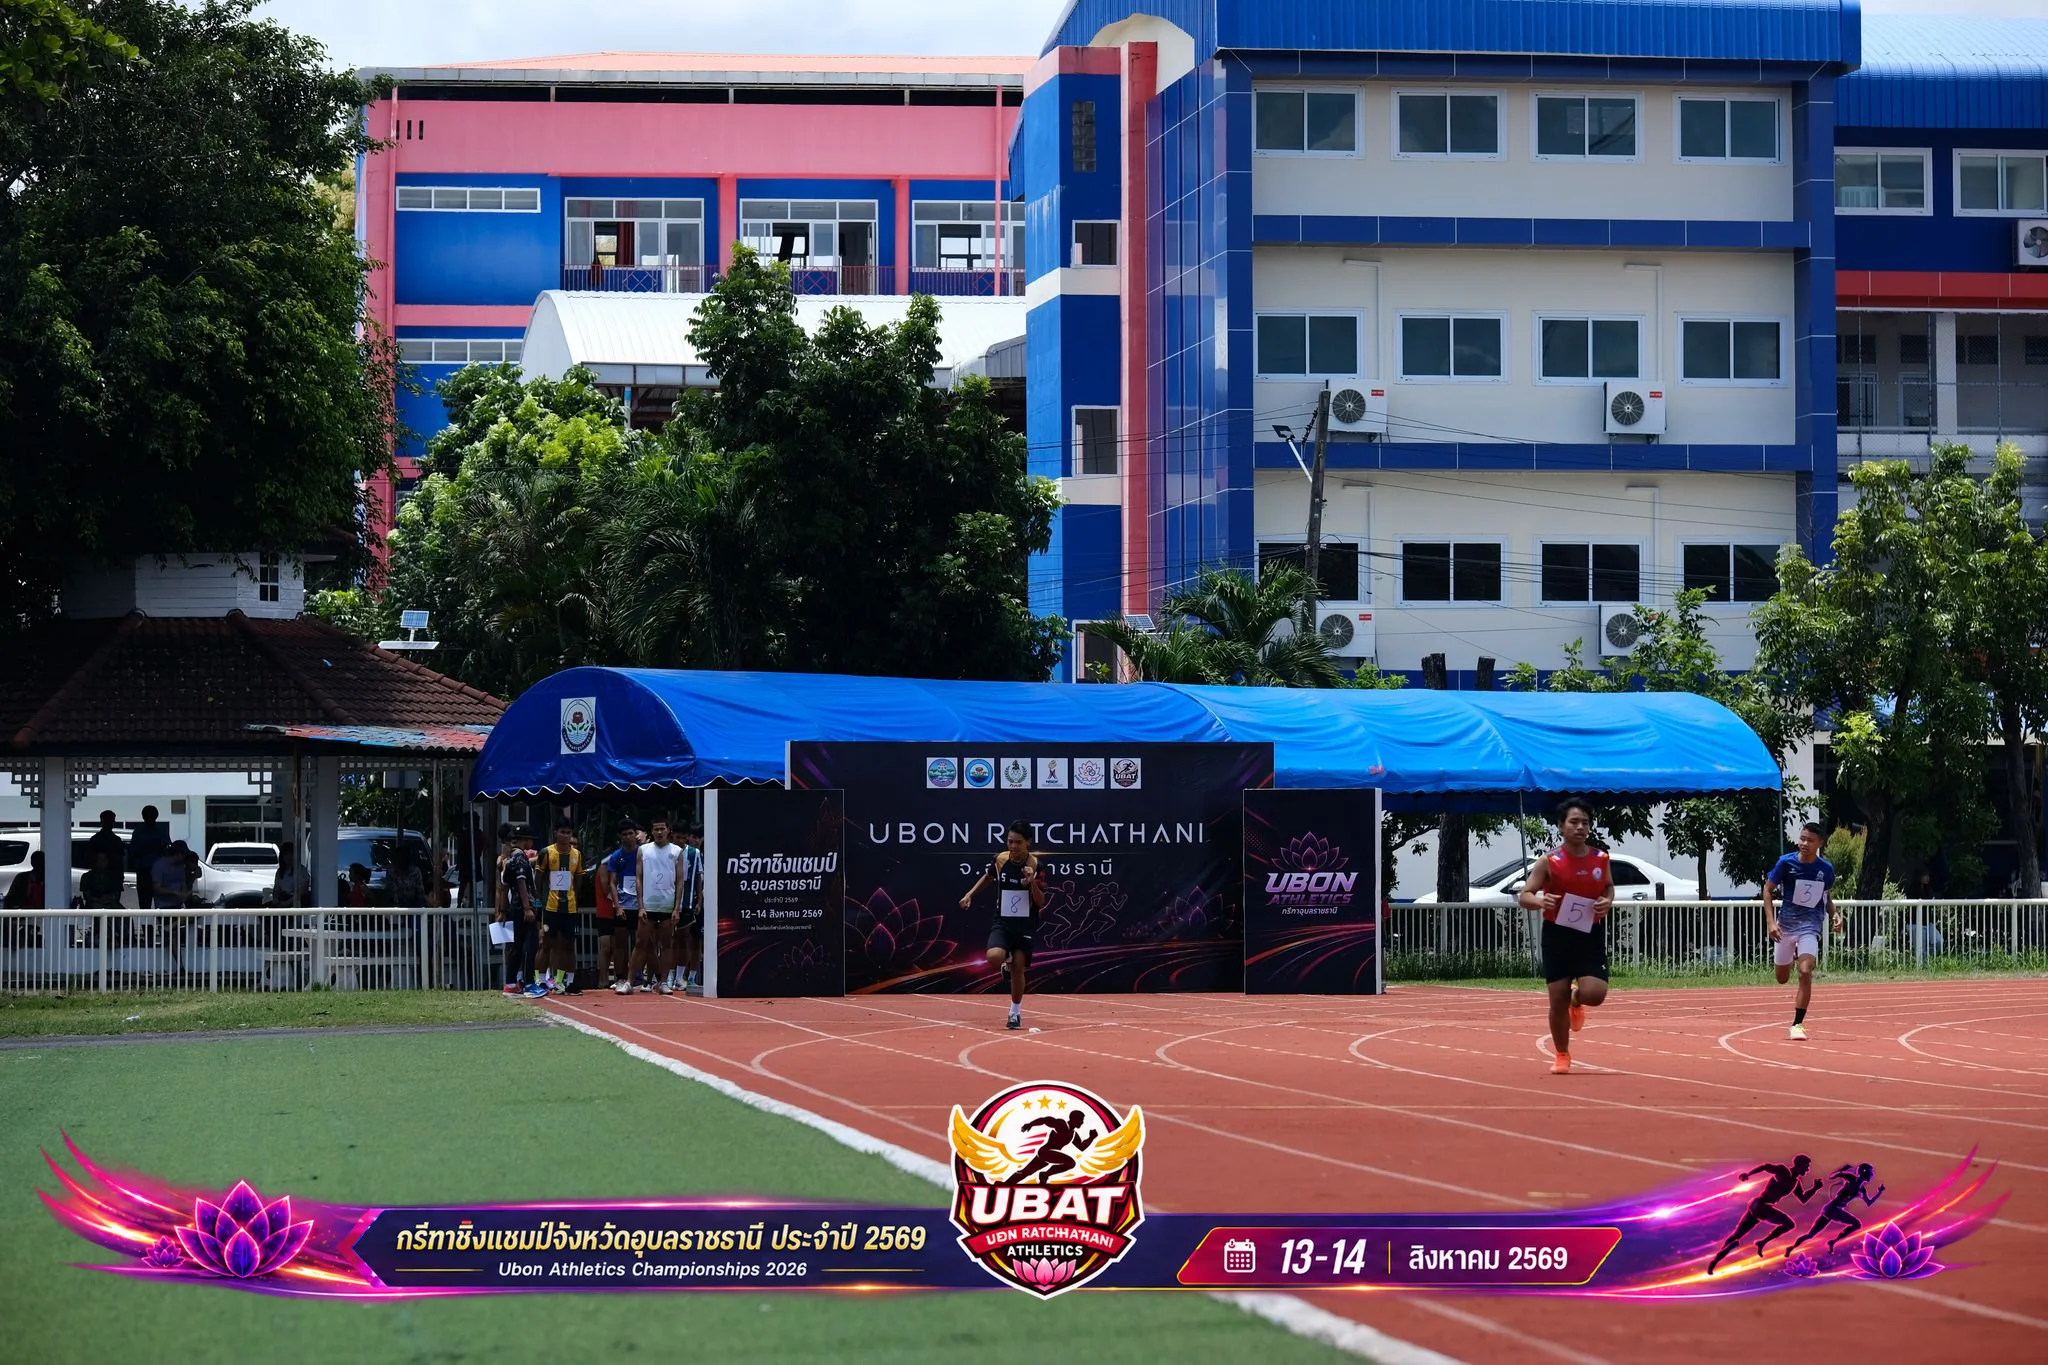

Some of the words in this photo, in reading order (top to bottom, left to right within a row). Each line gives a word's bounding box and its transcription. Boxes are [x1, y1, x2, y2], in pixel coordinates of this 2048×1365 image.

[869, 822, 969, 844] UBON
[987, 822, 1203, 844] RTCHATHANI
[656, 872, 664, 885] 2
[1265, 872, 1359, 893] UBON
[1265, 893, 1354, 905] ATHLETICS
[1800, 883, 1812, 904] 3
[769, 908, 800, 918] สิงหาคม
[802, 909, 823, 918] 2569
[1011, 895, 1022, 914] 8
[1566, 902, 1586, 924] 5
